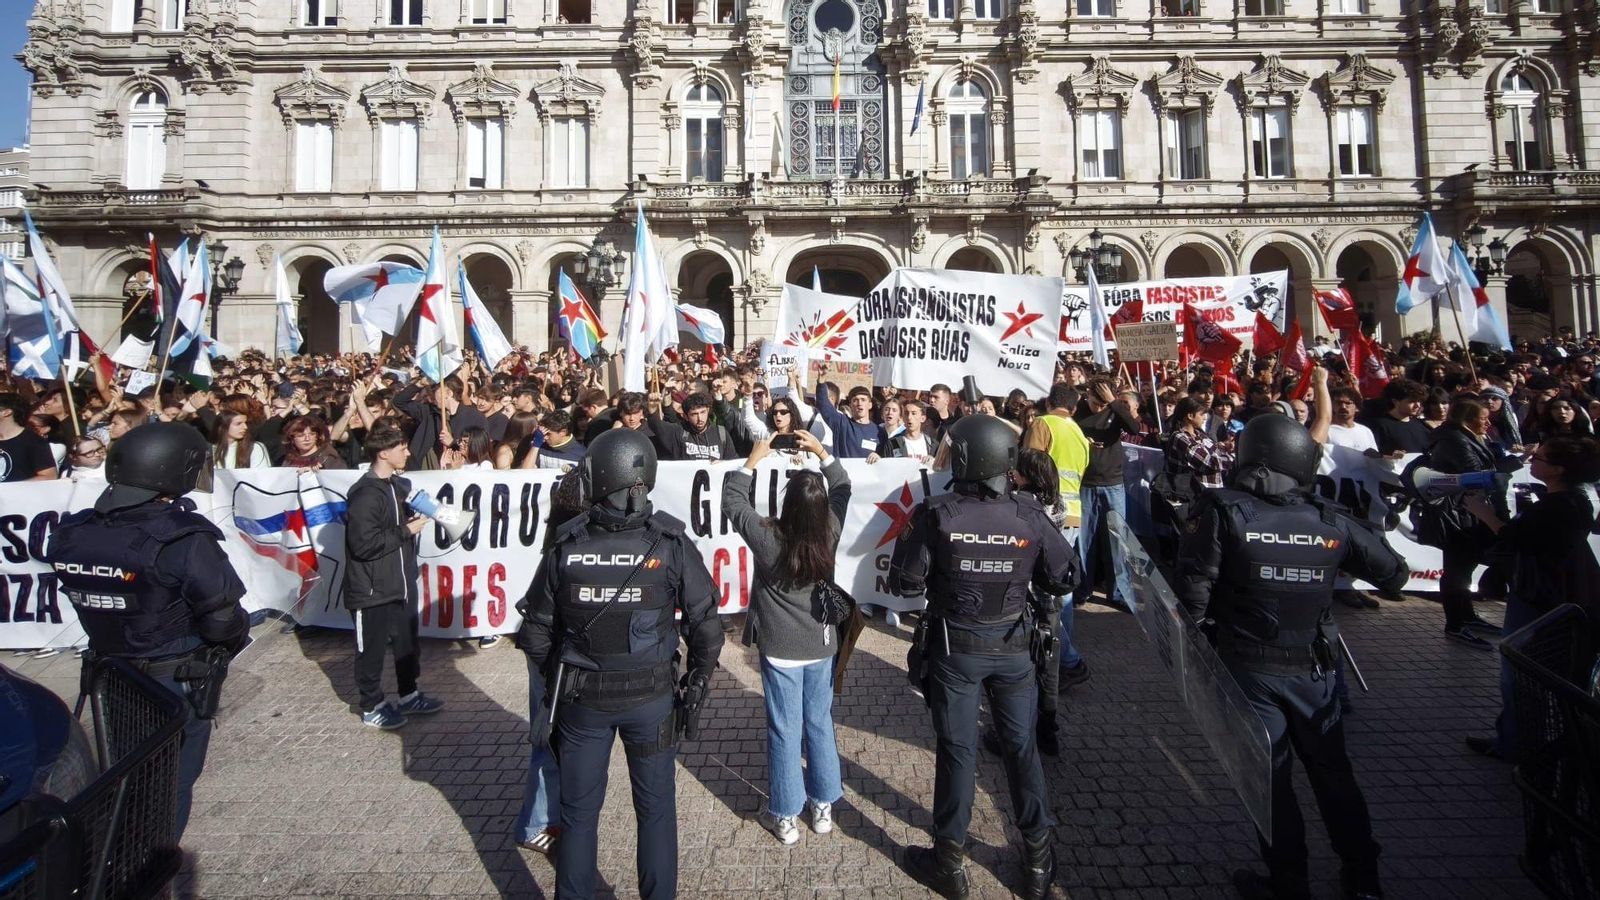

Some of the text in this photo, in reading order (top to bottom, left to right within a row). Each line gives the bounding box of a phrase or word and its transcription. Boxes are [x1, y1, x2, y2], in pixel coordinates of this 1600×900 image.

[931, 323, 970, 363] RÚAS
[1000, 343, 1040, 357] Galiza
[835, 361, 873, 375] VALORES
[997, 357, 1030, 371] Nova
[950, 532, 1018, 546] POLICIA
[1246, 532, 1326, 547] POLICIA
[567, 554, 648, 568] POLICIA
[55, 562, 125, 579] POLICIA
